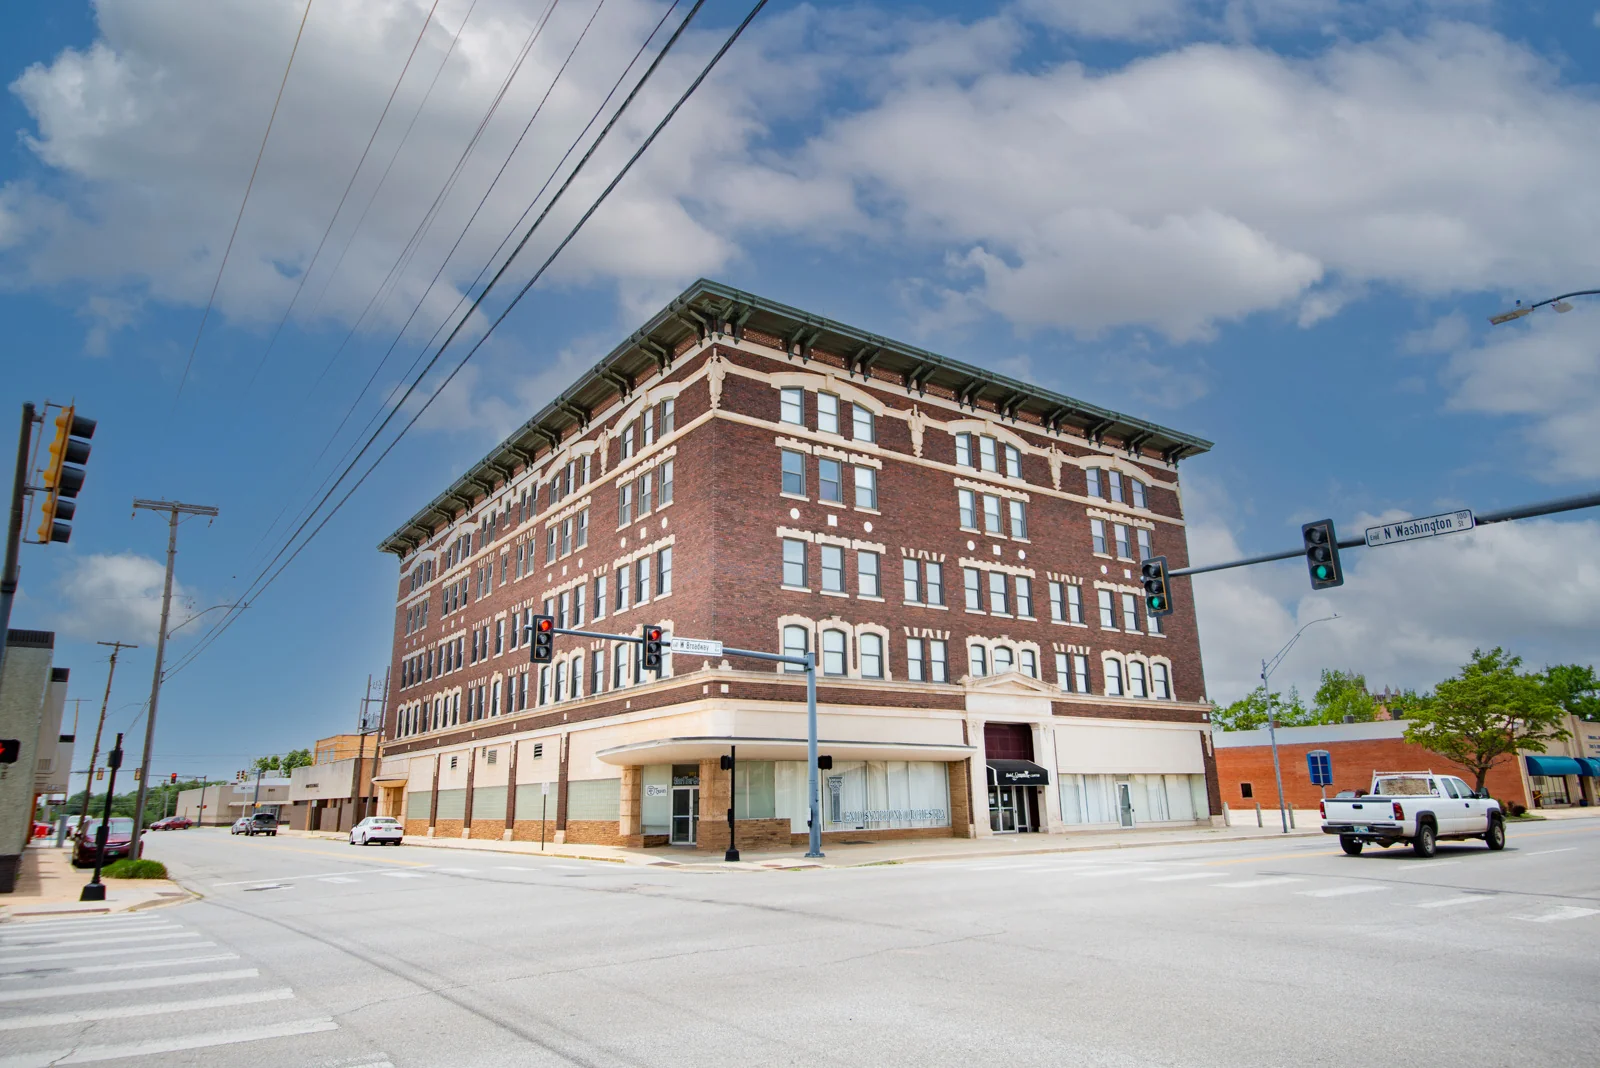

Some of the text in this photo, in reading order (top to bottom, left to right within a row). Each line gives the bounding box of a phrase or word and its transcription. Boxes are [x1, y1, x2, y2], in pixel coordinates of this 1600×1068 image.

[1456, 512, 1468, 521] 100
[1458, 520, 1465, 528] St
[1384, 527, 1392, 540] N
[1395, 518, 1452, 535] Washington
[686, 641, 710, 651] Broadway
